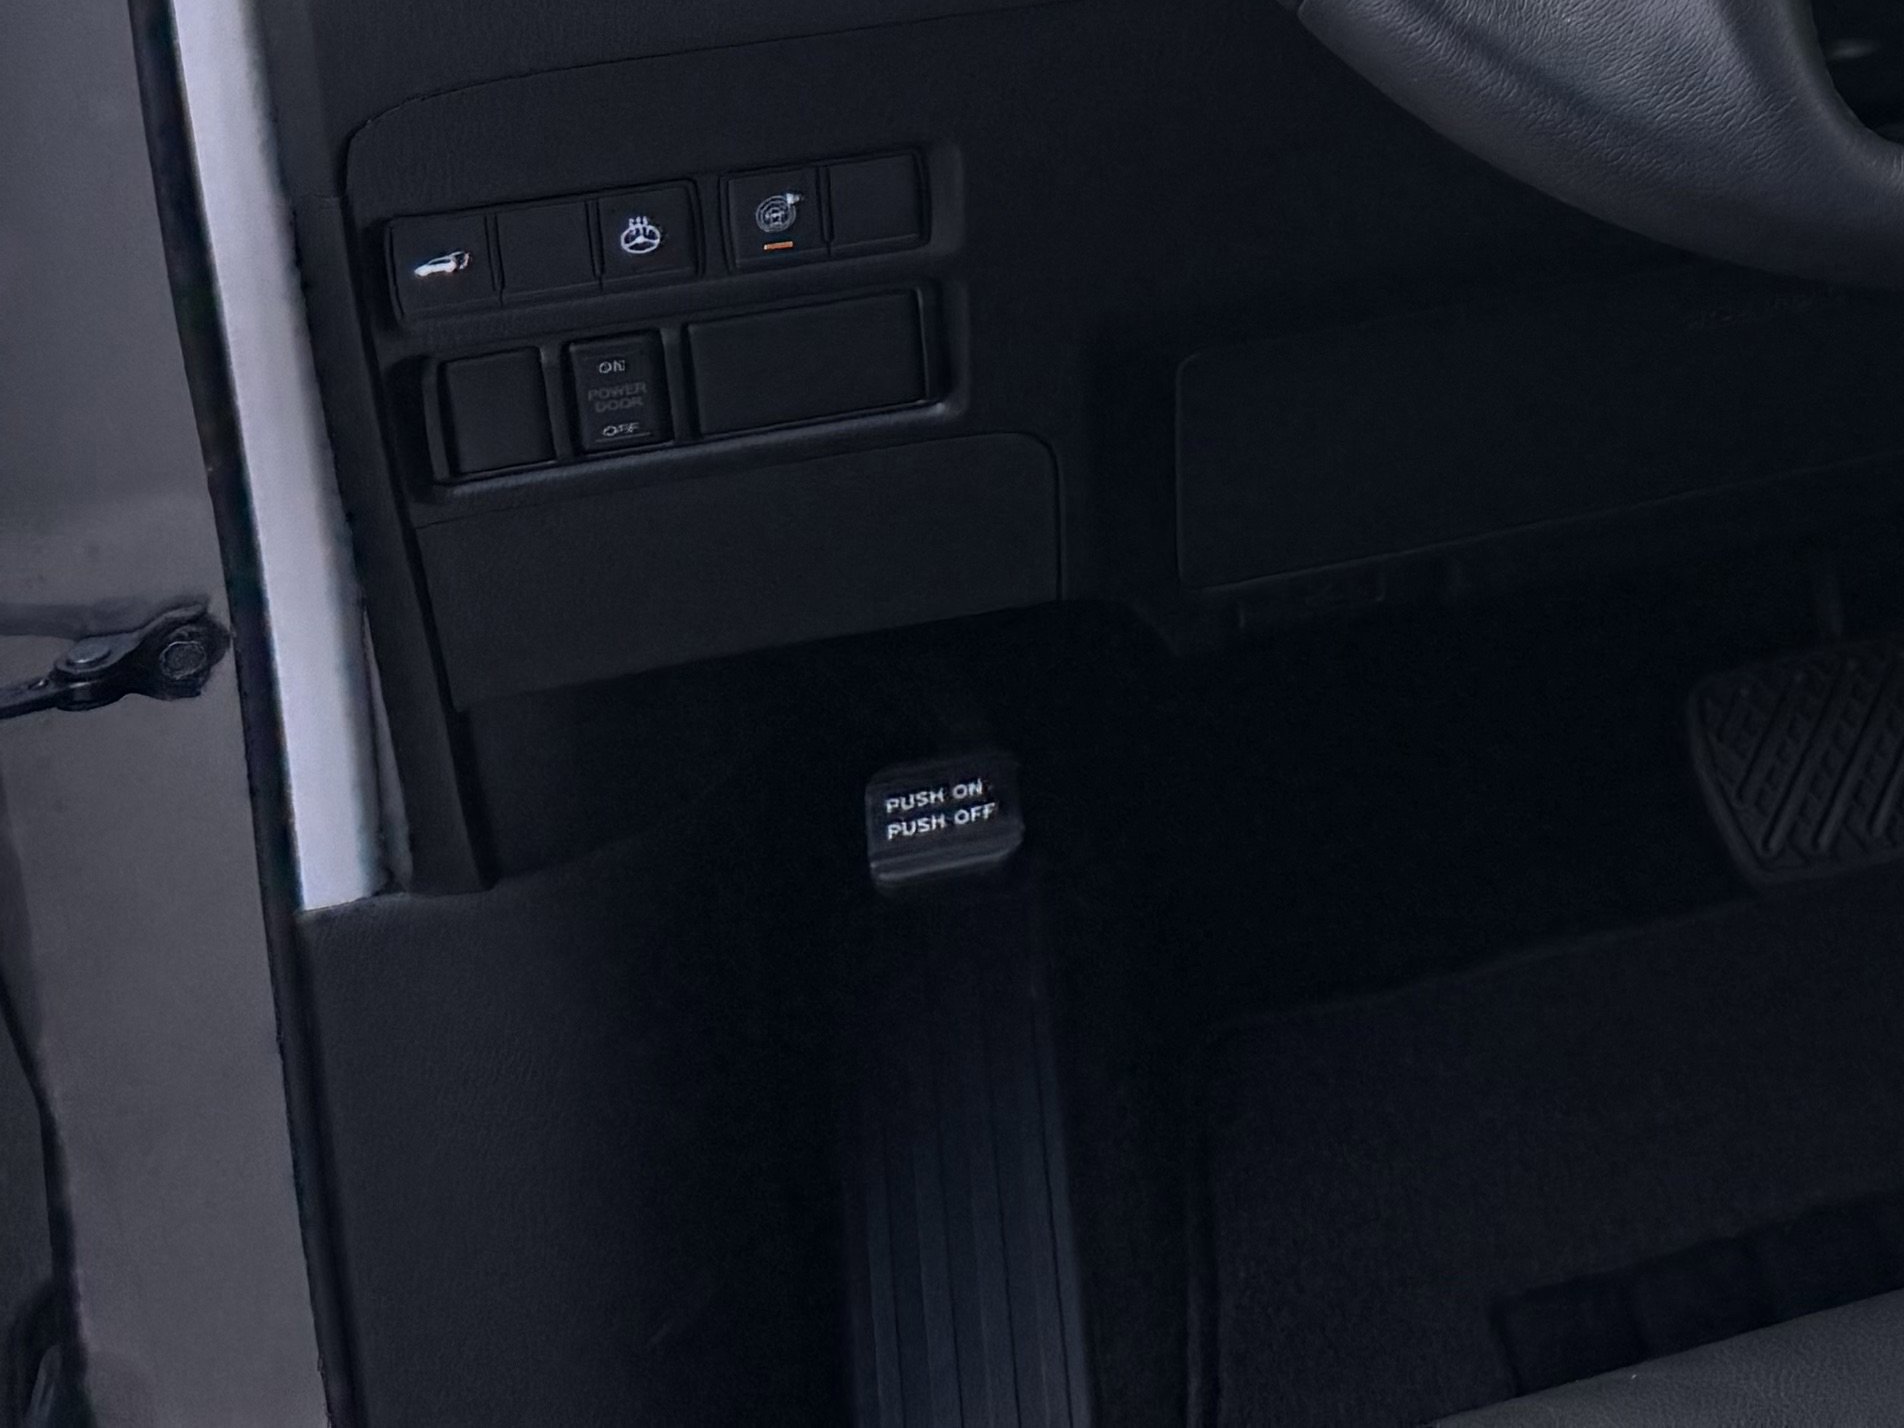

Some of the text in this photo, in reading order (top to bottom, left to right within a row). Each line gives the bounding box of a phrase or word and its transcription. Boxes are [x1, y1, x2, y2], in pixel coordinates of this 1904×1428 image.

[598, 358, 627, 375] ON
[587, 382, 648, 402] POWER
[594, 394, 645, 414] DOOR
[602, 421, 641, 438] OFF
[885, 777, 983, 814] PUSH ON
[886, 801, 998, 840] PUSH OFF
